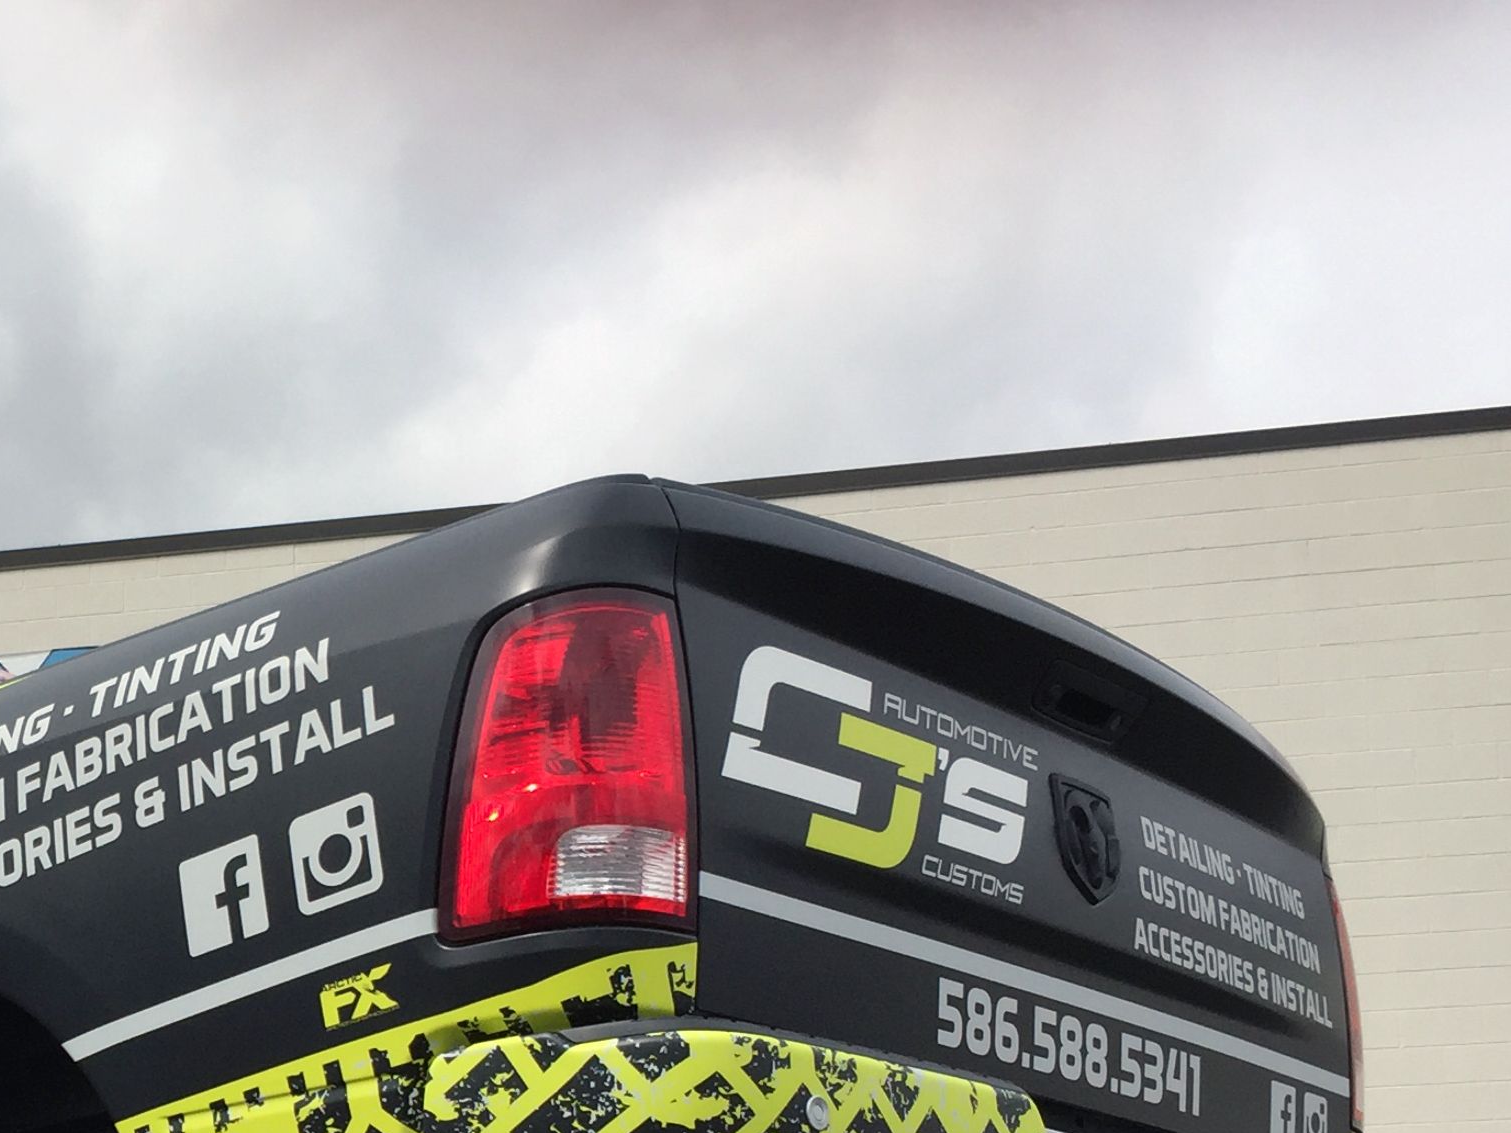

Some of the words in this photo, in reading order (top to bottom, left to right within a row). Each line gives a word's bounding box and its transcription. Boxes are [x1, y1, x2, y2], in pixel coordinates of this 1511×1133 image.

[89, 610, 280, 718] TINTING
[16, 637, 330, 814] FABRICATION
[135, 780, 166, 828] &
[177, 686, 395, 813] INSTALL
[884, 692, 1038, 771] AUTOMOTIVE
[921, 854, 1023, 905] CUSTOMS
[1139, 866, 1217, 928] CUSTOM
[1218, 899, 1321, 975] FABRICATION
[1140, 815, 1235, 885] DETAILING
[1243, 862, 1305, 920] TINTING
[1134, 917, 1254, 994] ACCESSORIES
[1257, 966, 1269, 1001] &
[1271, 972, 1333, 1029] INSTALL
[937, 976, 1201, 1117] 586.588.5341
